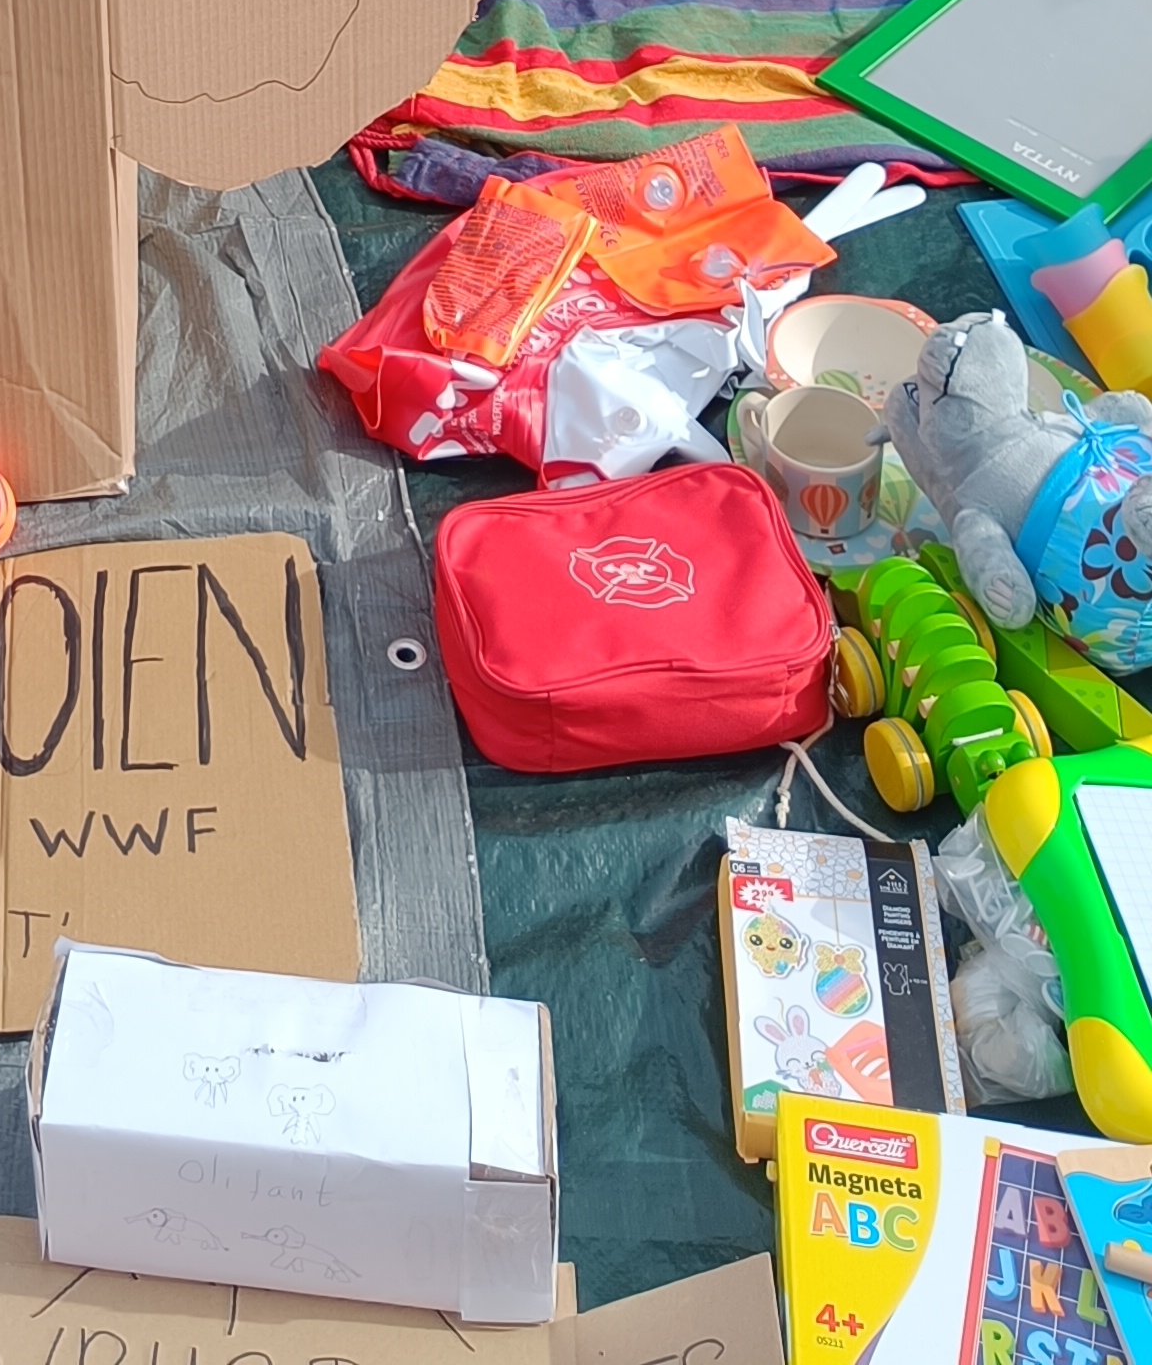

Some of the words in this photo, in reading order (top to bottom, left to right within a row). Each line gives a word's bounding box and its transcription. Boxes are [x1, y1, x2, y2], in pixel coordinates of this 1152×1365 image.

[1012, 140, 1080, 183] NYTTJA
[29, 807, 217, 858] WWF
[732, 863, 746, 874] 06
[882, 905, 911, 914] DIAMOND
[811, 1122, 911, 1159] Quercetti
[808, 1163, 922, 1199] Magneta
[810, 1191, 919, 1251] ABC
[994, 1186, 1028, 1238] A
[1033, 1196, 1071, 1249] B
[987, 1249, 1019, 1302] J
[1029, 1258, 1065, 1317] K
[1076, 1268, 1108, 1327] L
[816, 1303, 864, 1336] 4+
[816, 1336, 844, 1348] 05211
